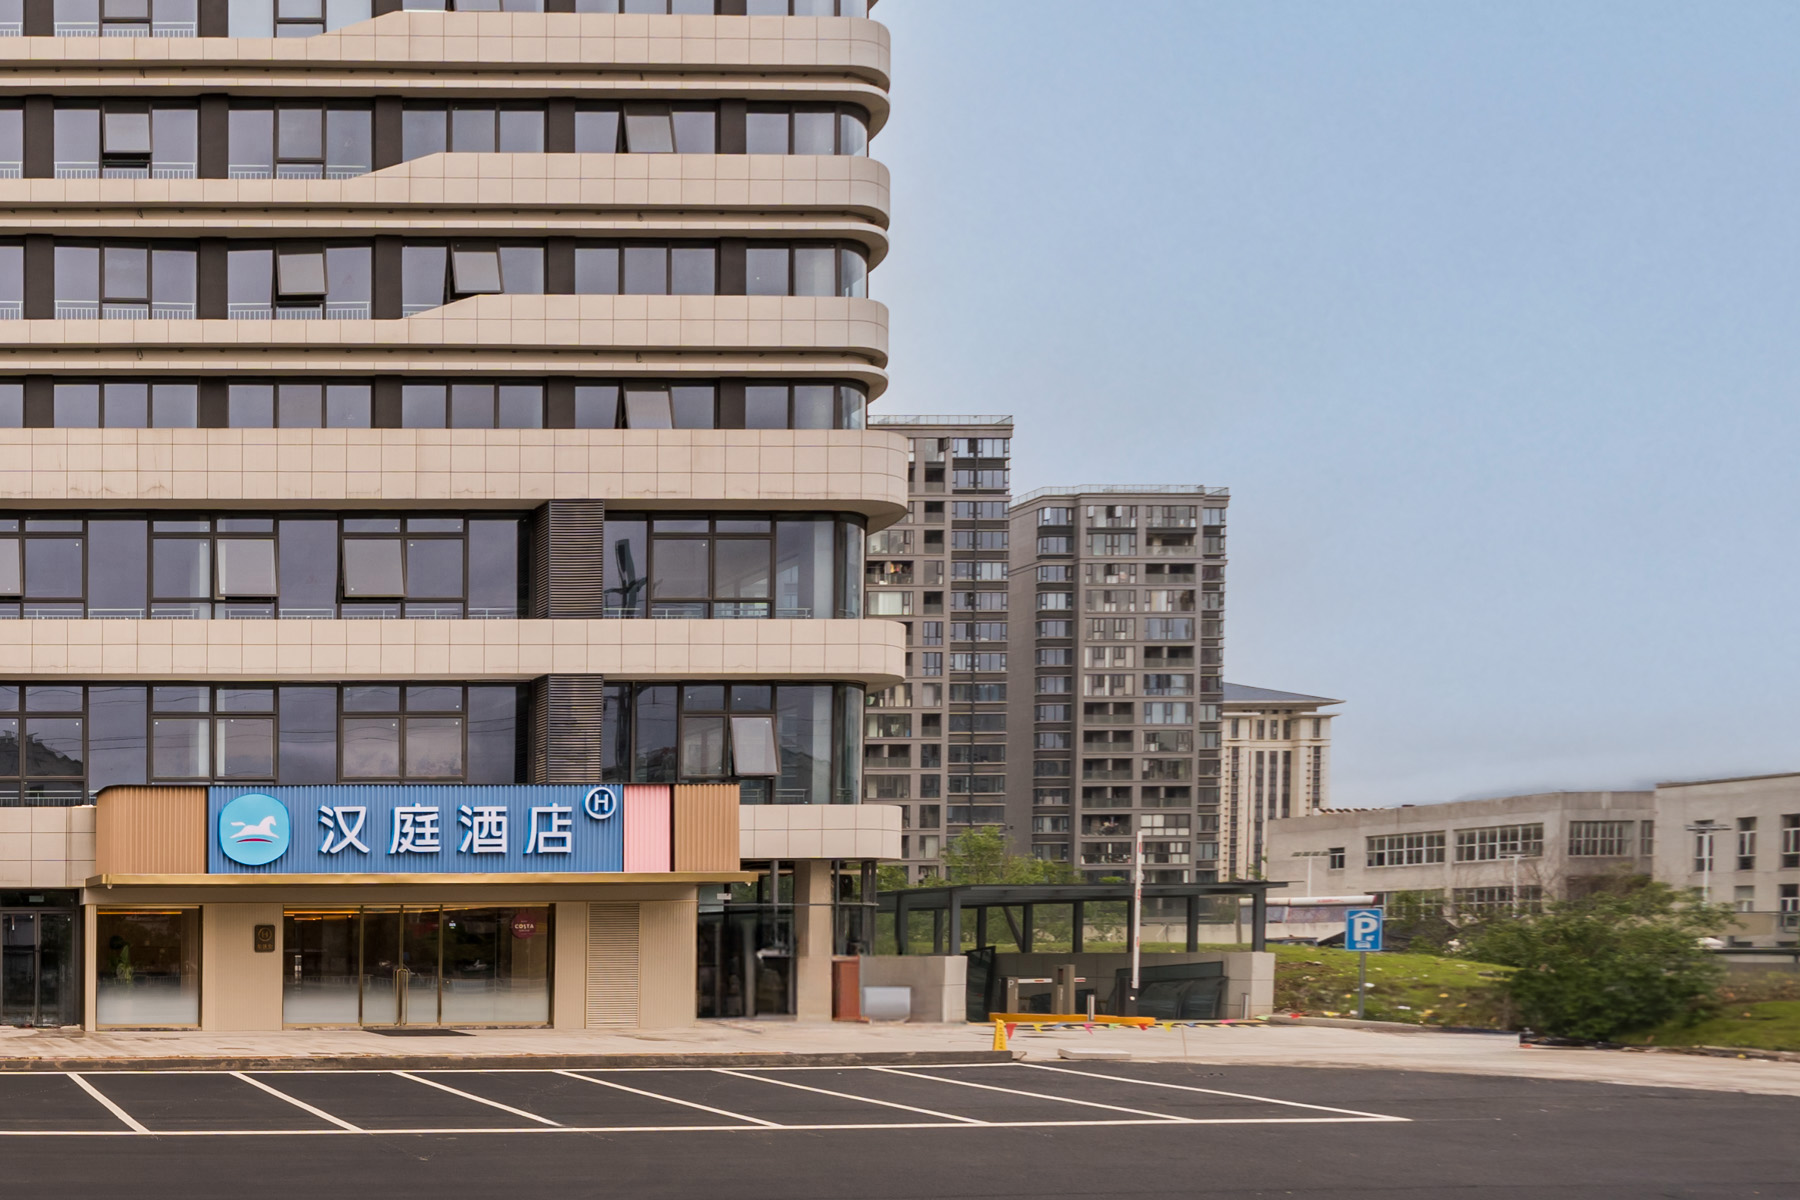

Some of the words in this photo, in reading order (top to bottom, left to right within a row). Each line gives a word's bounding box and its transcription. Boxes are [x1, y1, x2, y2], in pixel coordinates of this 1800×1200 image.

[317, 802, 573, 854] 汉庭酒店
[1353, 917, 1378, 941] P
